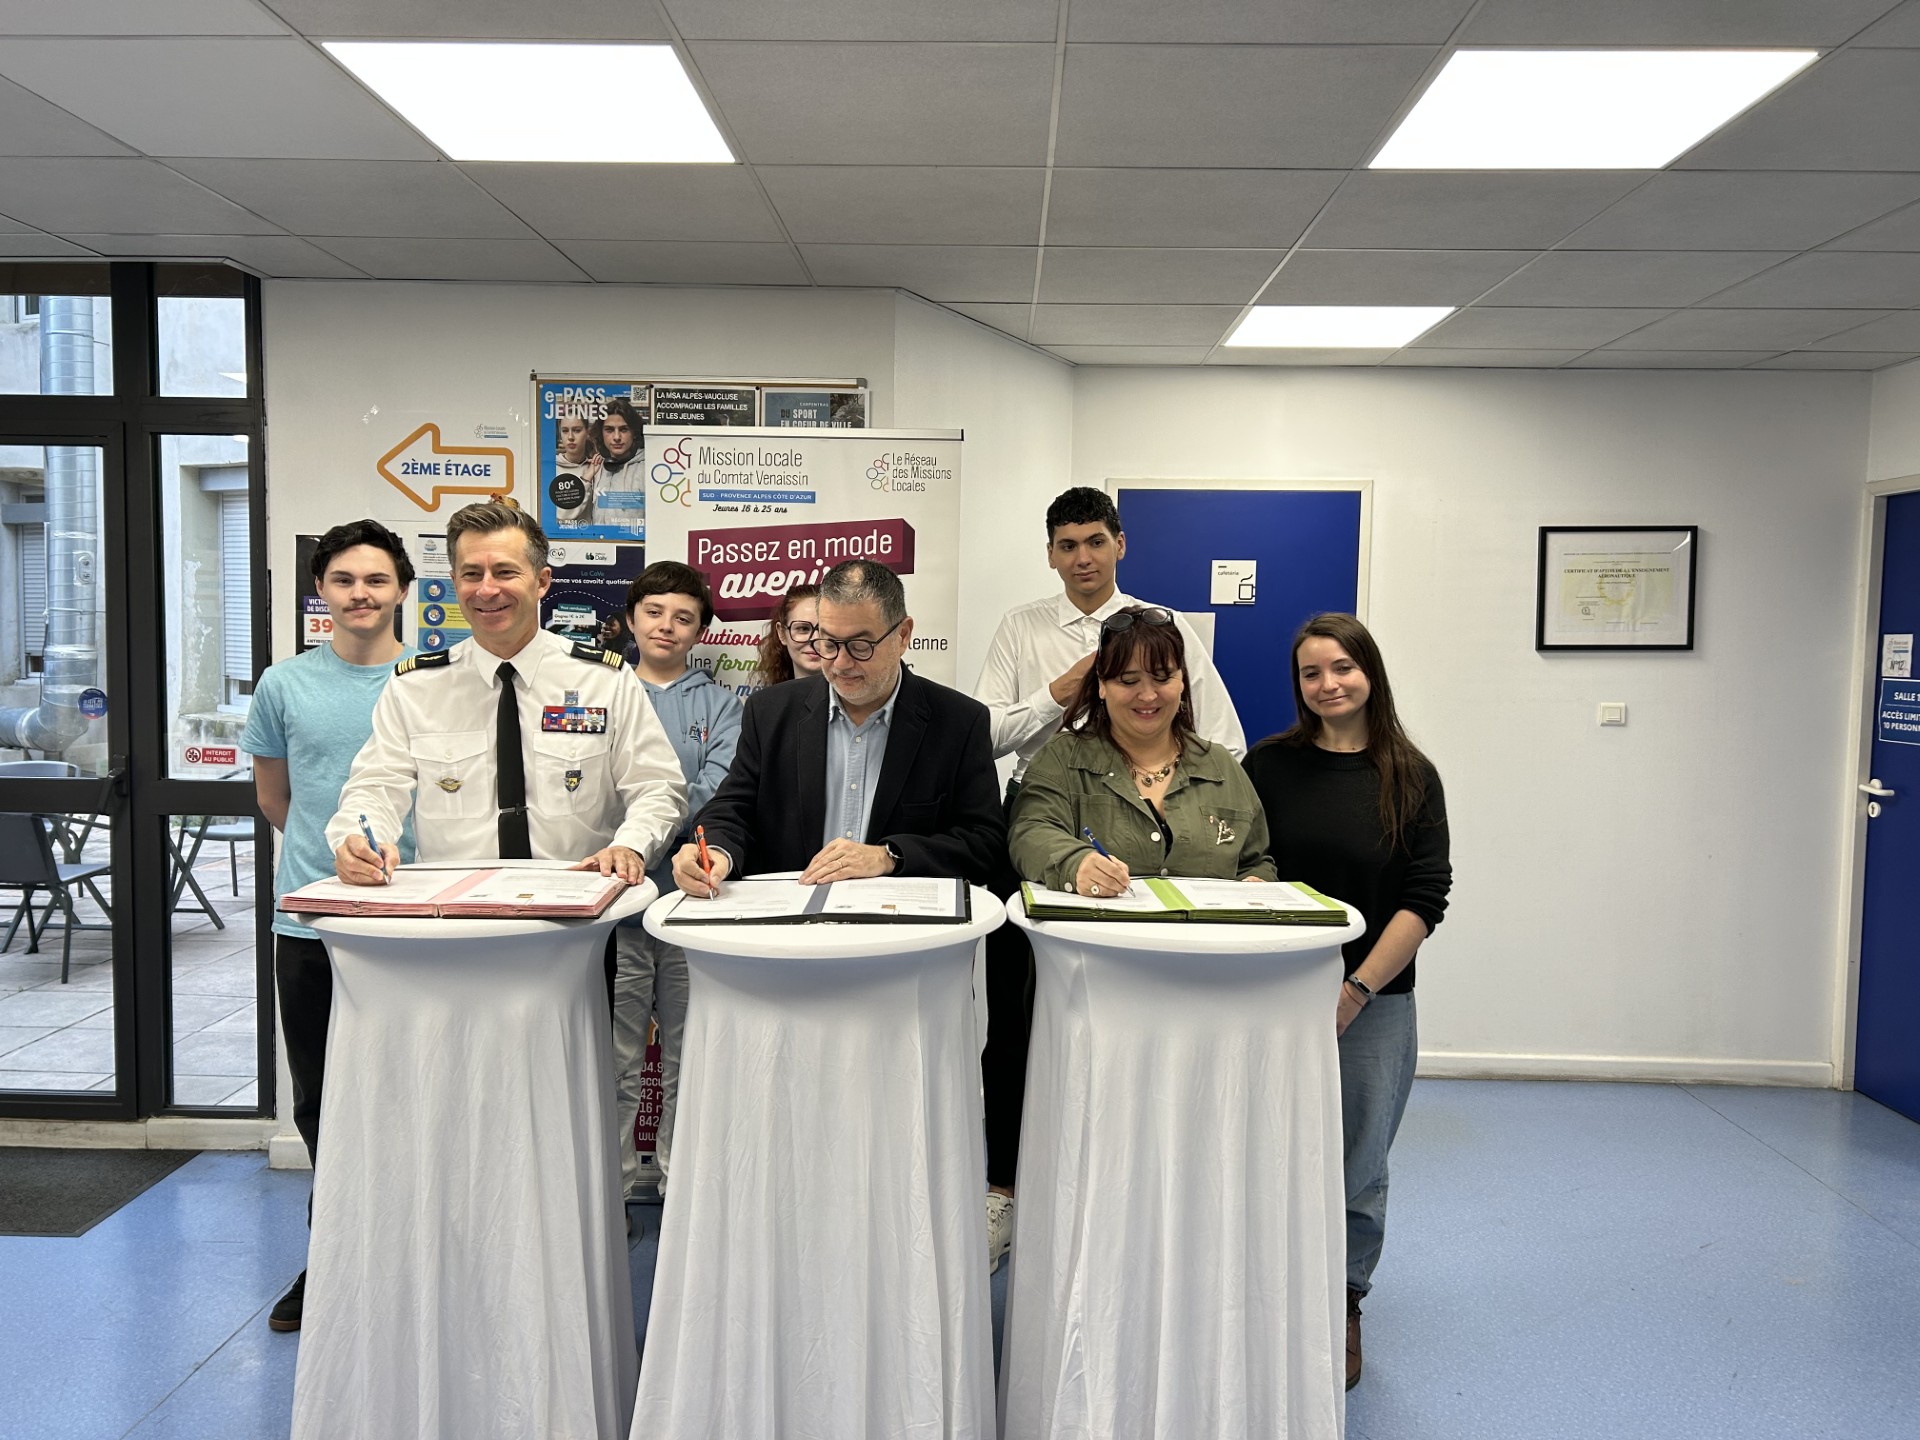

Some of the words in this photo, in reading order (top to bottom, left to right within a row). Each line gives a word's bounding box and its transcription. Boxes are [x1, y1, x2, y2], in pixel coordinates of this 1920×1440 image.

[544, 387, 606, 403] e-PASS
[682, 392, 738, 400] ALPES-VAUCLUSE
[544, 404, 608, 420] JEUNES
[656, 402, 702, 410] ACCOMPAGNE
[780, 409, 790, 418] DU
[792, 409, 818, 419] SPORT
[698, 446, 754, 466] Mission
[758, 447, 802, 467] Locale
[892, 452, 902, 466] Le
[904, 452, 937, 466] Réseau
[401, 458, 440, 476] 2ÈME
[445, 459, 491, 476] ÉTAGE
[892, 466, 908, 479] des
[910, 466, 952, 480] Missions
[698, 470, 711, 484] du
[714, 469, 754, 485] Comtat
[756, 470, 809, 486] Venaissin
[892, 479, 926, 492] Locales
[712, 504, 739, 512] Jeunes
[741, 504, 751, 512] 16
[753, 504, 760, 512] à
[761, 505, 772, 513] 25
[698, 538, 780, 564] Passez
[787, 538, 816, 558] en
[824, 529, 892, 557] mode
[719, 558, 831, 598] aveni
[310, 618, 334, 634] 39
[697, 628, 762, 646] lutions
[712, 652, 760, 678] form
[1894, 692, 1916, 701] SALLE
[1882, 710, 1904, 720] ACCÈS
[640, 1088, 653, 1100] 42
[640, 1102, 652, 1114] 16
[640, 1116, 660, 1127] 842
